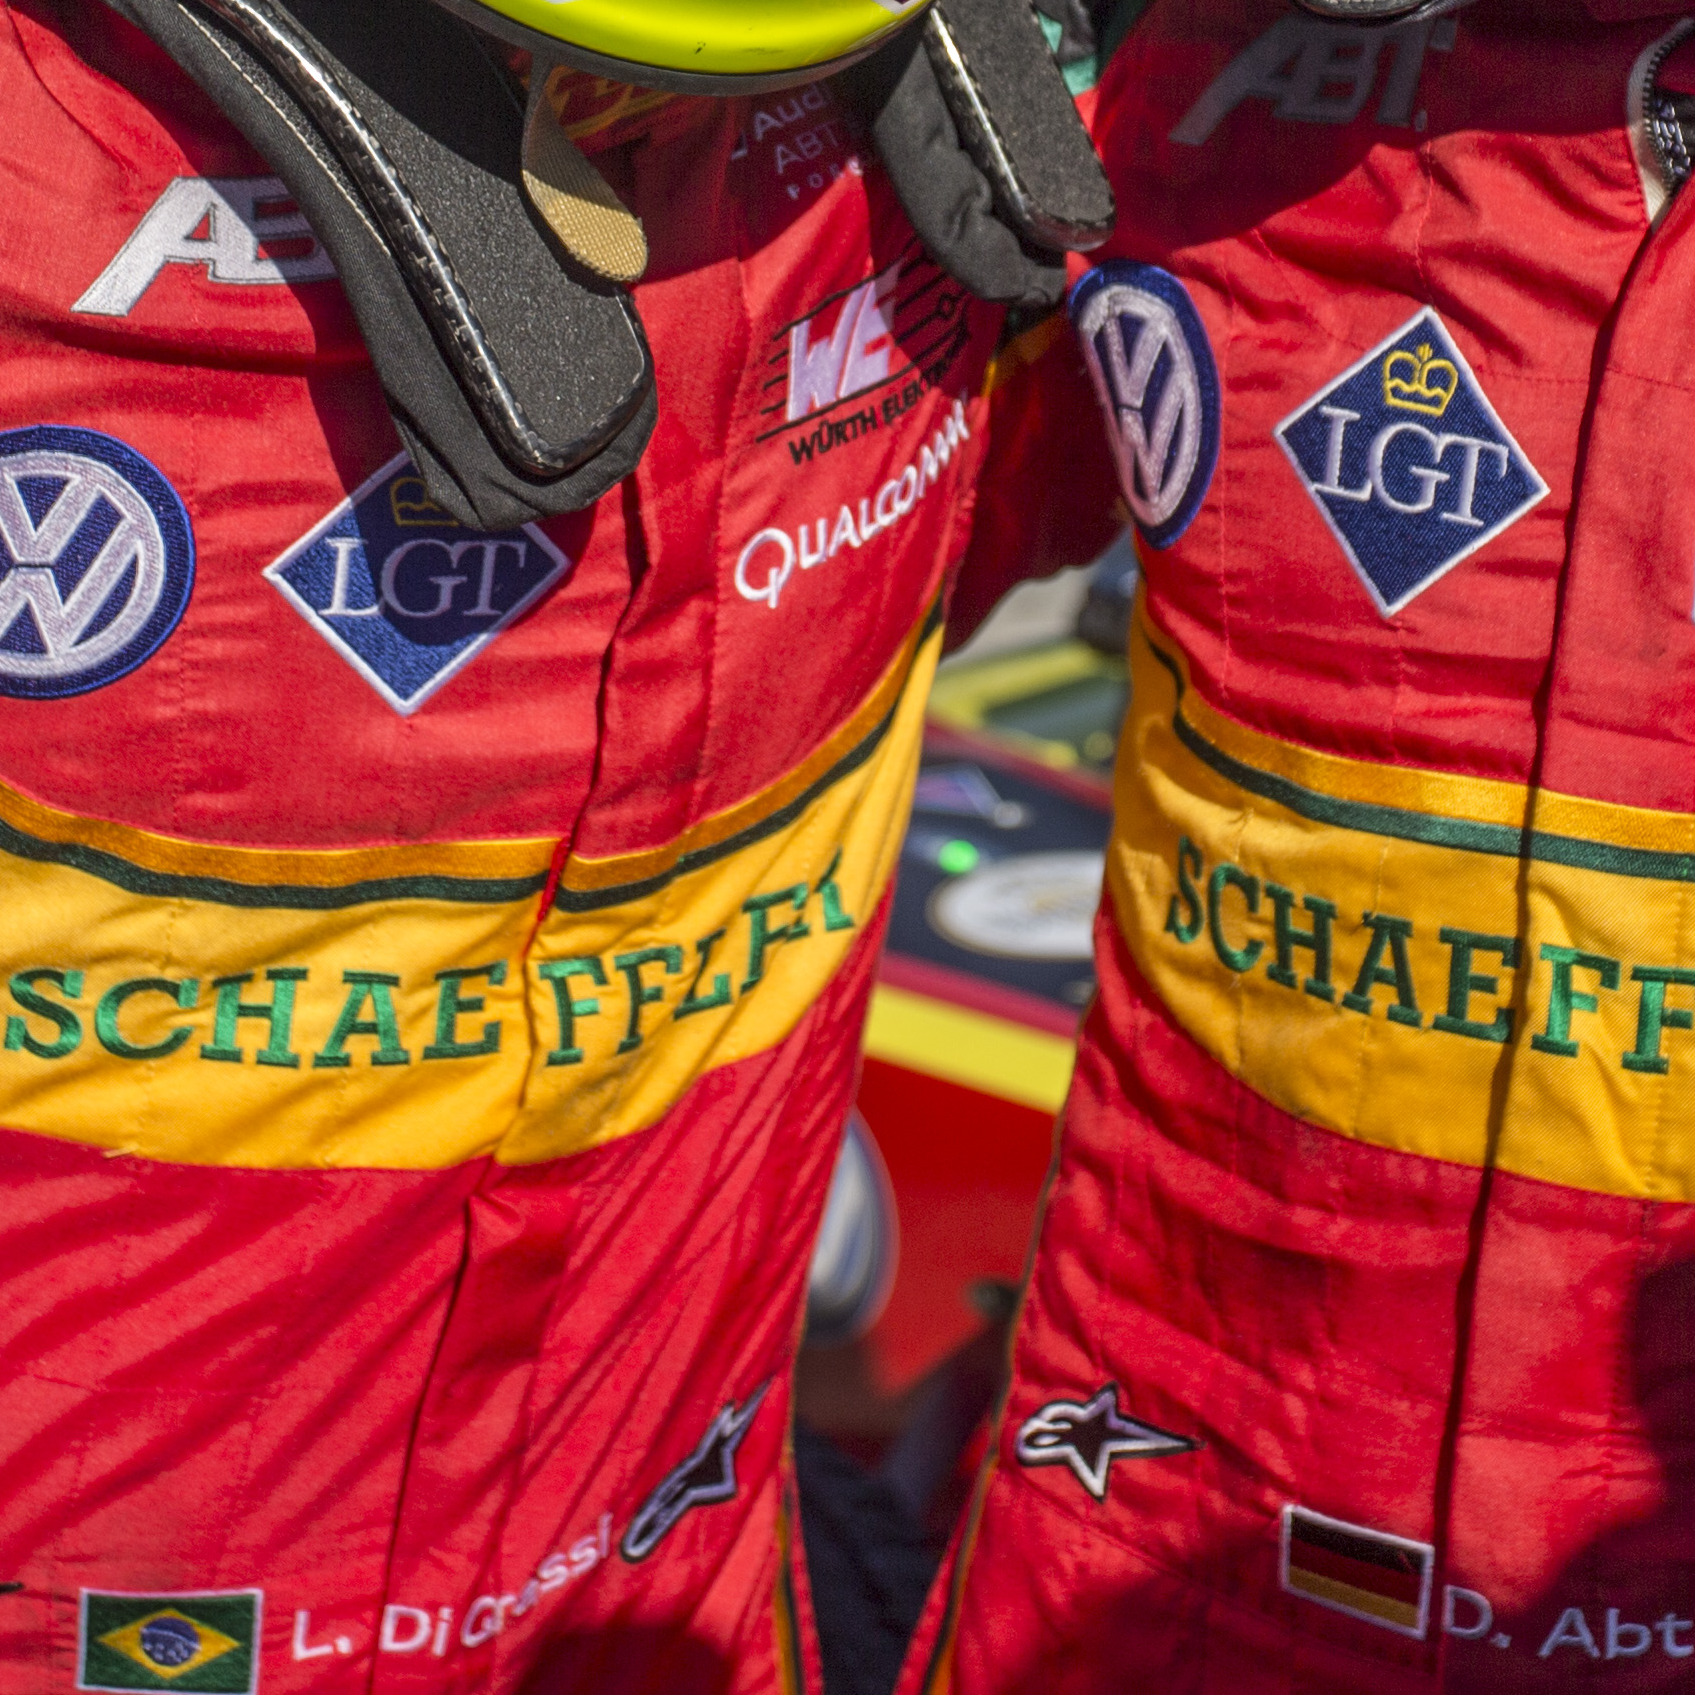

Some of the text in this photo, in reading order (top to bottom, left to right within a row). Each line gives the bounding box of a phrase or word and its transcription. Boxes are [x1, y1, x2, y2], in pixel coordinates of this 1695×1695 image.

[1167, 11, 1459, 147] ABT
[71, 175, 342, 317] AB
[1310, 405, 1508, 528] LGT
[317, 535, 528, 620] LGT
[378, 1603, 454, 1657] Di
[1538, 1605, 1695, 1661] Abt
